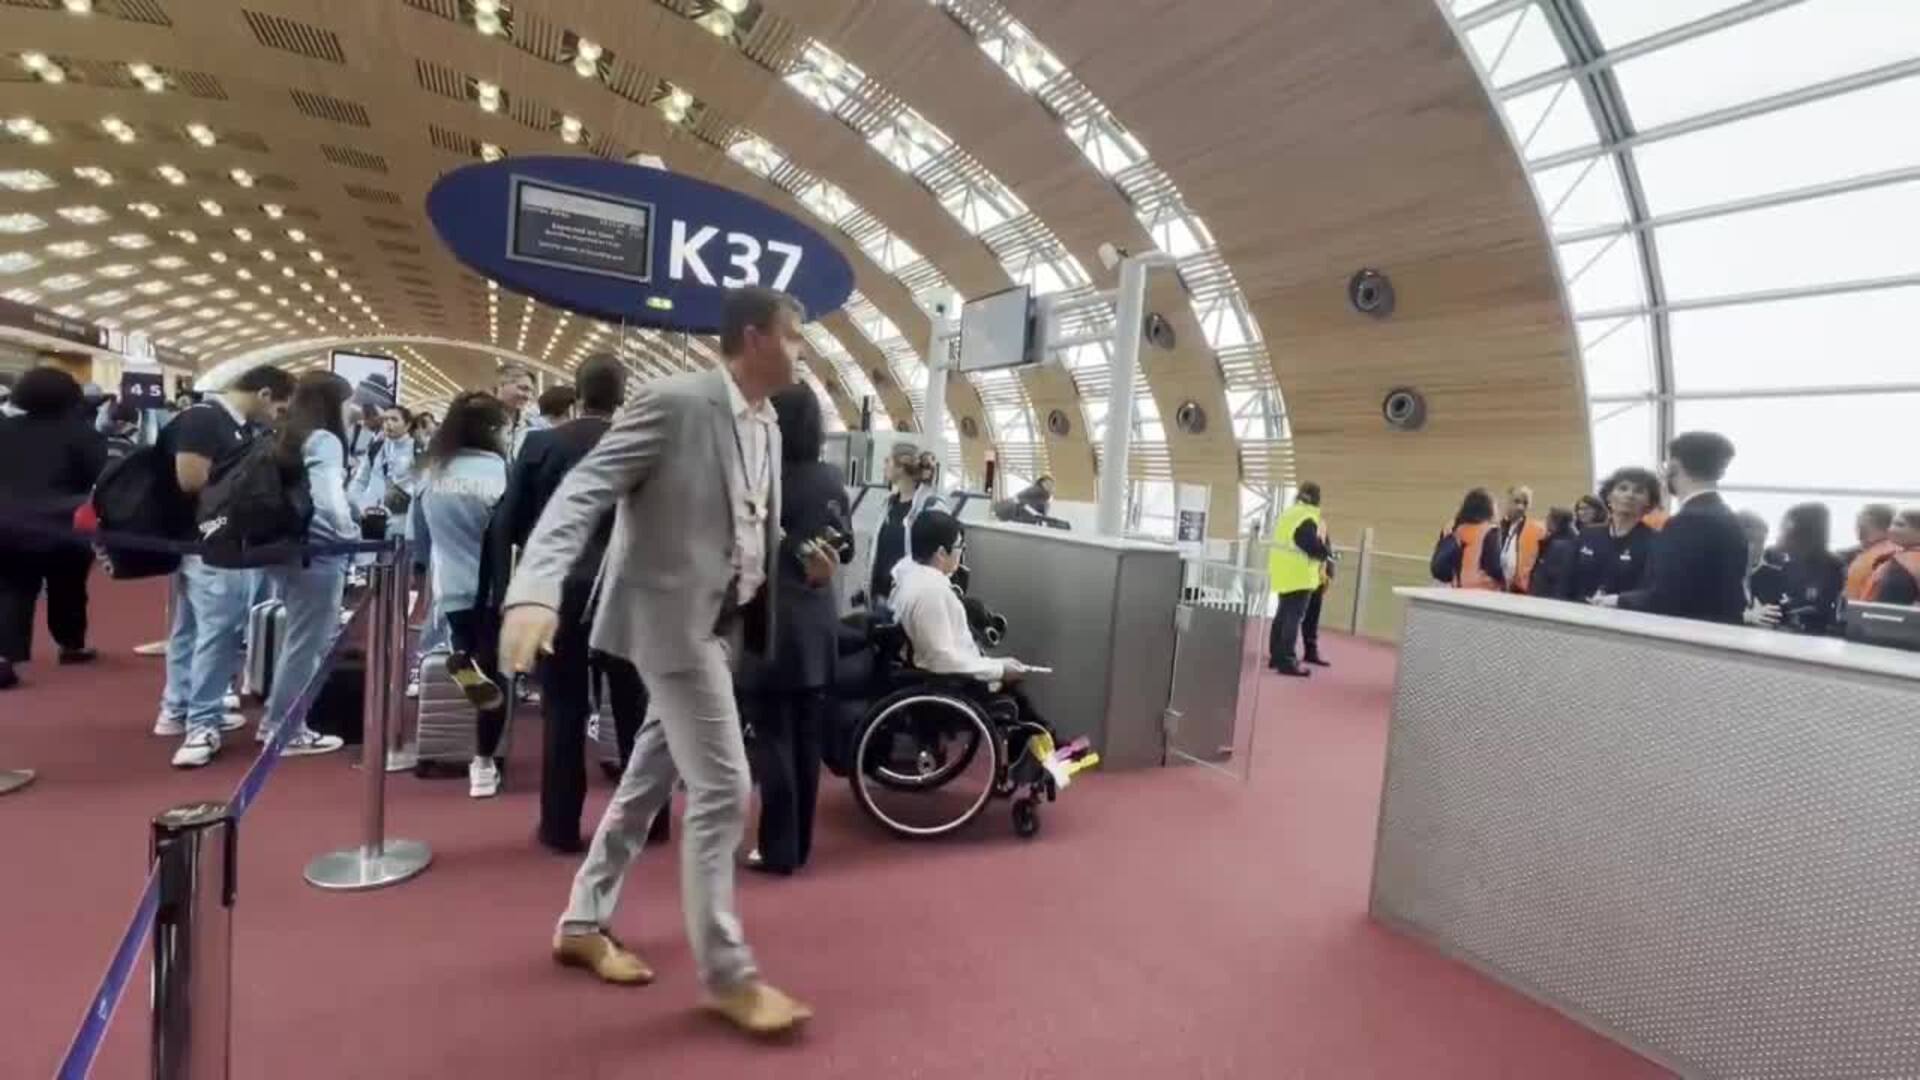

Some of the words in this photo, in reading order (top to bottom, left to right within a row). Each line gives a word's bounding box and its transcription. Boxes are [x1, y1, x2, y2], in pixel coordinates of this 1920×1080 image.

[668, 218, 803, 293] K37
[129, 383, 144, 397] 4
[149, 384, 162, 398] 5
